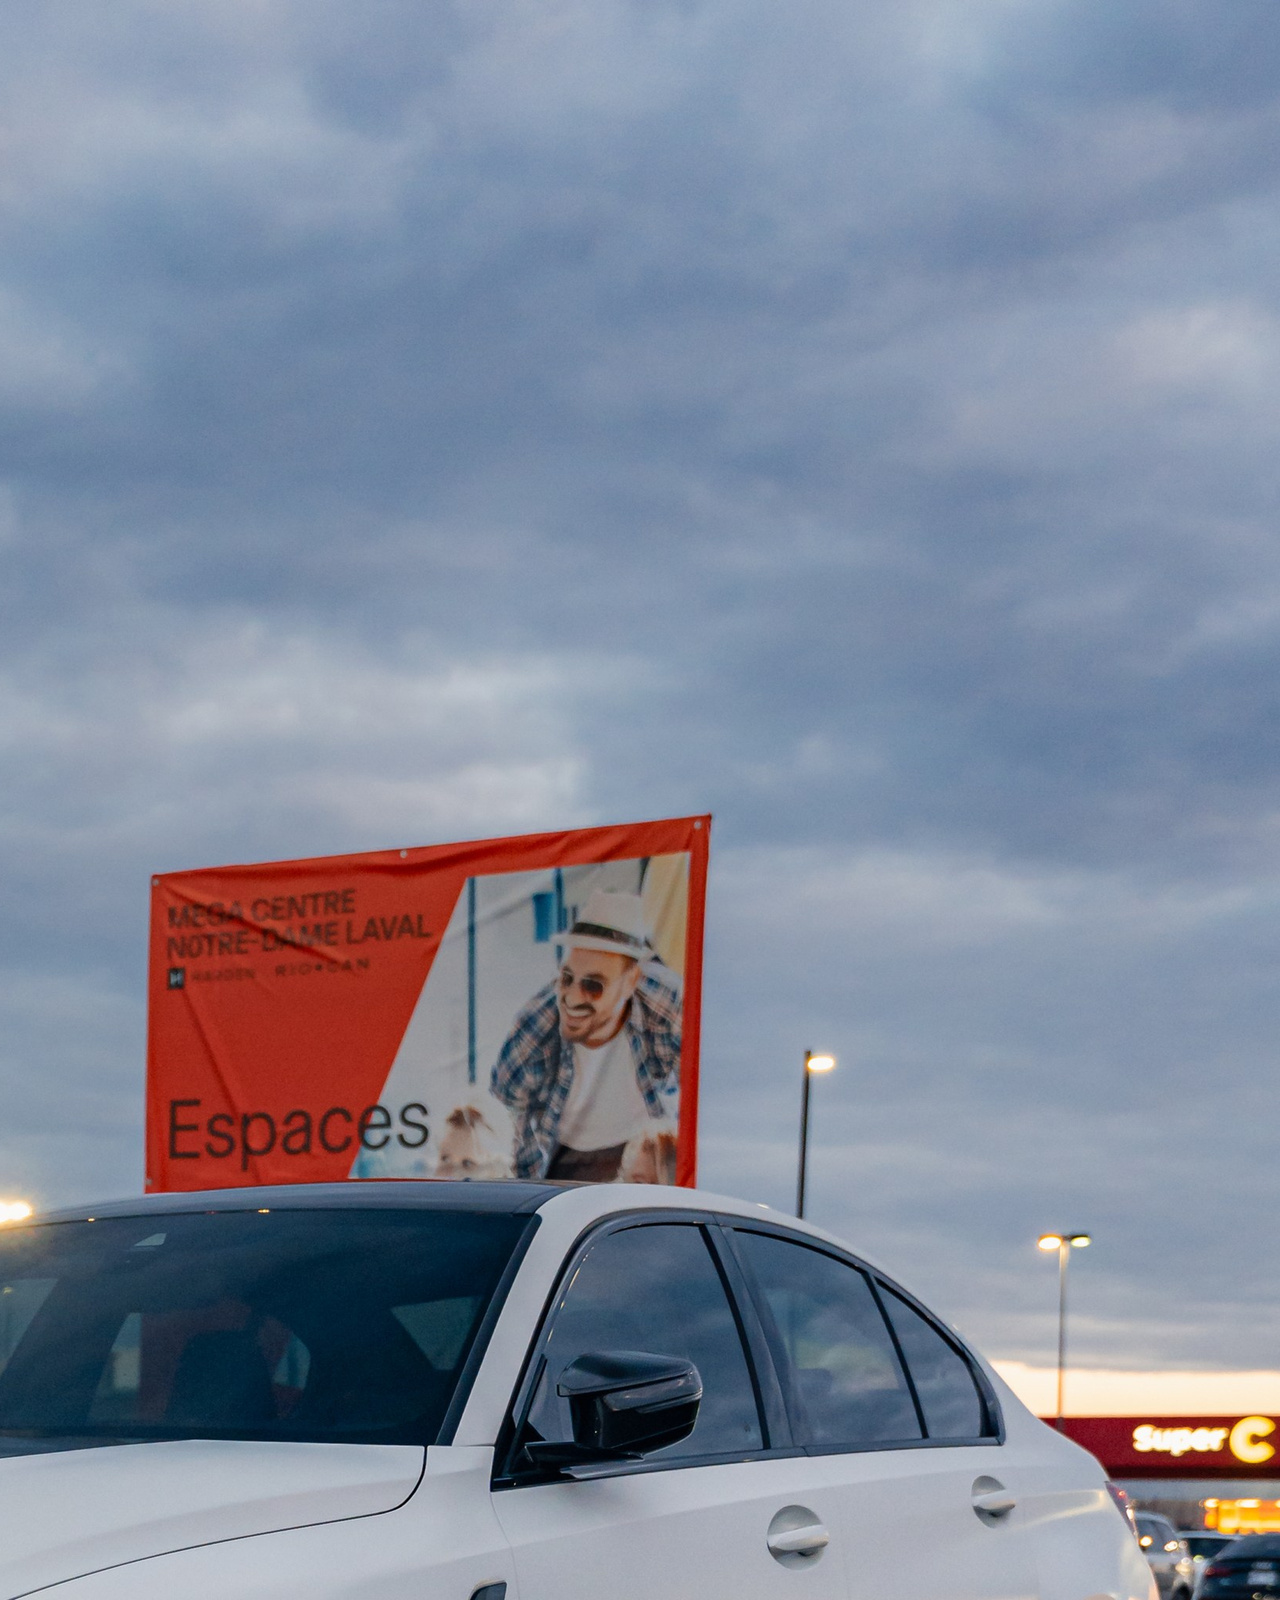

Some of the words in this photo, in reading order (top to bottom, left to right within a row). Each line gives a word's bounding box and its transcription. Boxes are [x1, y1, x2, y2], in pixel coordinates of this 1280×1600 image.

[250, 888, 356, 922] CENTRE
[167, 921, 339, 959] NOTRE-DAME
[346, 914, 433, 945] LAVAL
[169, 1099, 430, 1172] Espaces
[1132, 1423, 1229, 1457] Super
[1229, 1415, 1276, 1463] C
